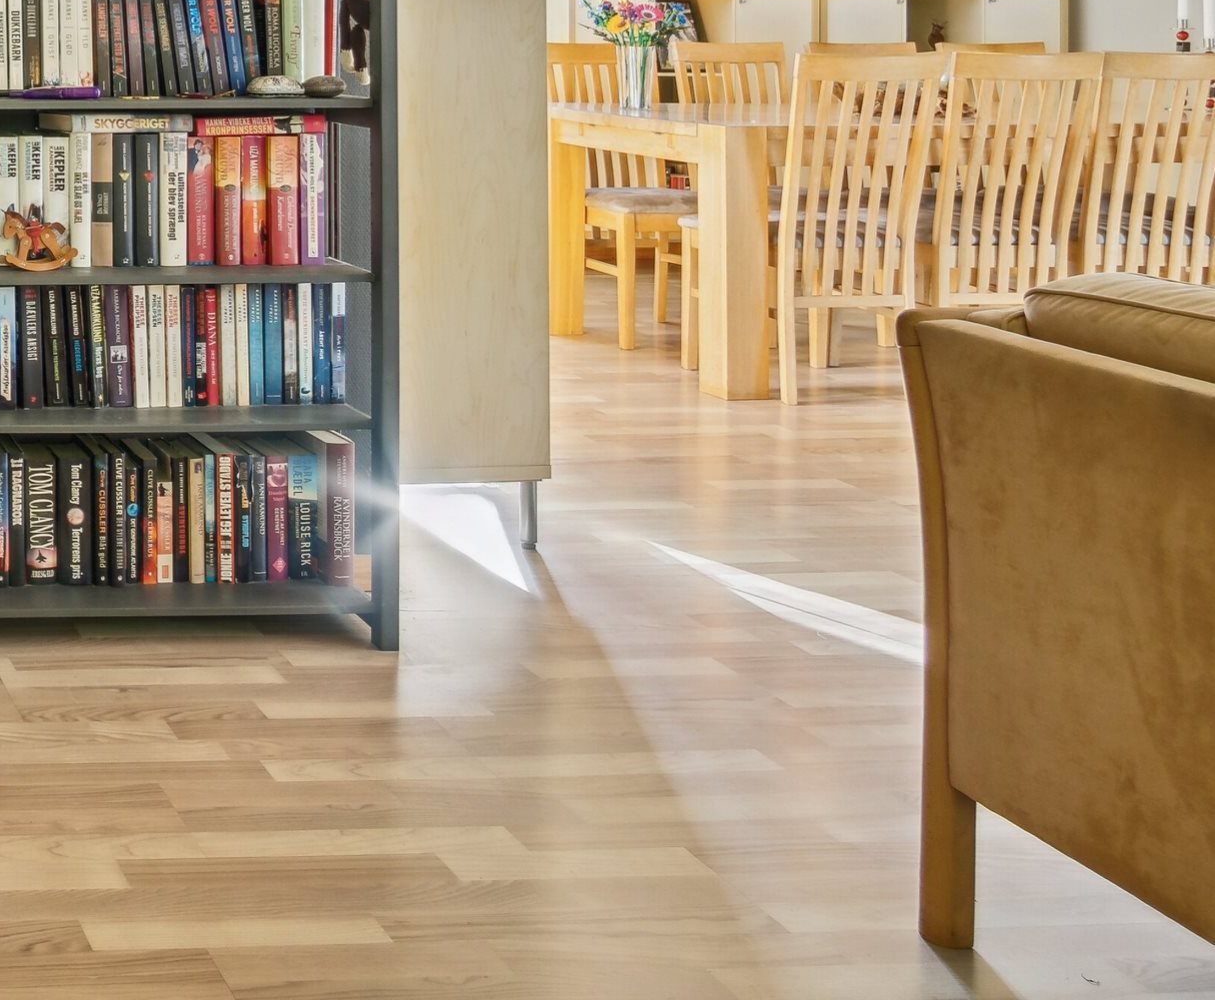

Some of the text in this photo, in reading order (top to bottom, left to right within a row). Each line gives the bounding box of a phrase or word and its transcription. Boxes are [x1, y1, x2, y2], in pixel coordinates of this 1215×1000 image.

[10, 11, 21, 61] DUKKEBARN
[190, 8, 201, 35] WOLF
[208, 8, 218, 34] WOLF
[225, 8, 235, 33] WOLF
[243, 16, 253, 32] WOLF
[272, 7, 280, 30] ROMA
[205, 124, 273, 135] KRONPRINSESSEN
[8, 147, 16, 178] KEPLER
[32, 146, 41, 180] KEPLER
[54, 151, 65, 191] KEPLER
[167, 172, 178, 241] der blev sprængt
[177, 172, 185, 223] Luftkastellet
[25, 301, 38, 361] DJÆVLENS ANSIGT
[207, 312, 217, 346] DIANA
[28, 464, 54, 495] TOM
[115, 458, 123, 480] CLIVE
[98, 489, 106, 533] CUSSLER
[219, 456, 231, 537] JEG LEVER STADIG
[28, 499, 54, 551] CLANCY
[68, 463, 84, 580] Tom Clancy Terrorens pris
[299, 502, 311, 566] LOUISE RICK
[333, 496, 343, 561] RAVENSBRÜCK
[342, 497, 351, 552] KVINDERNE
